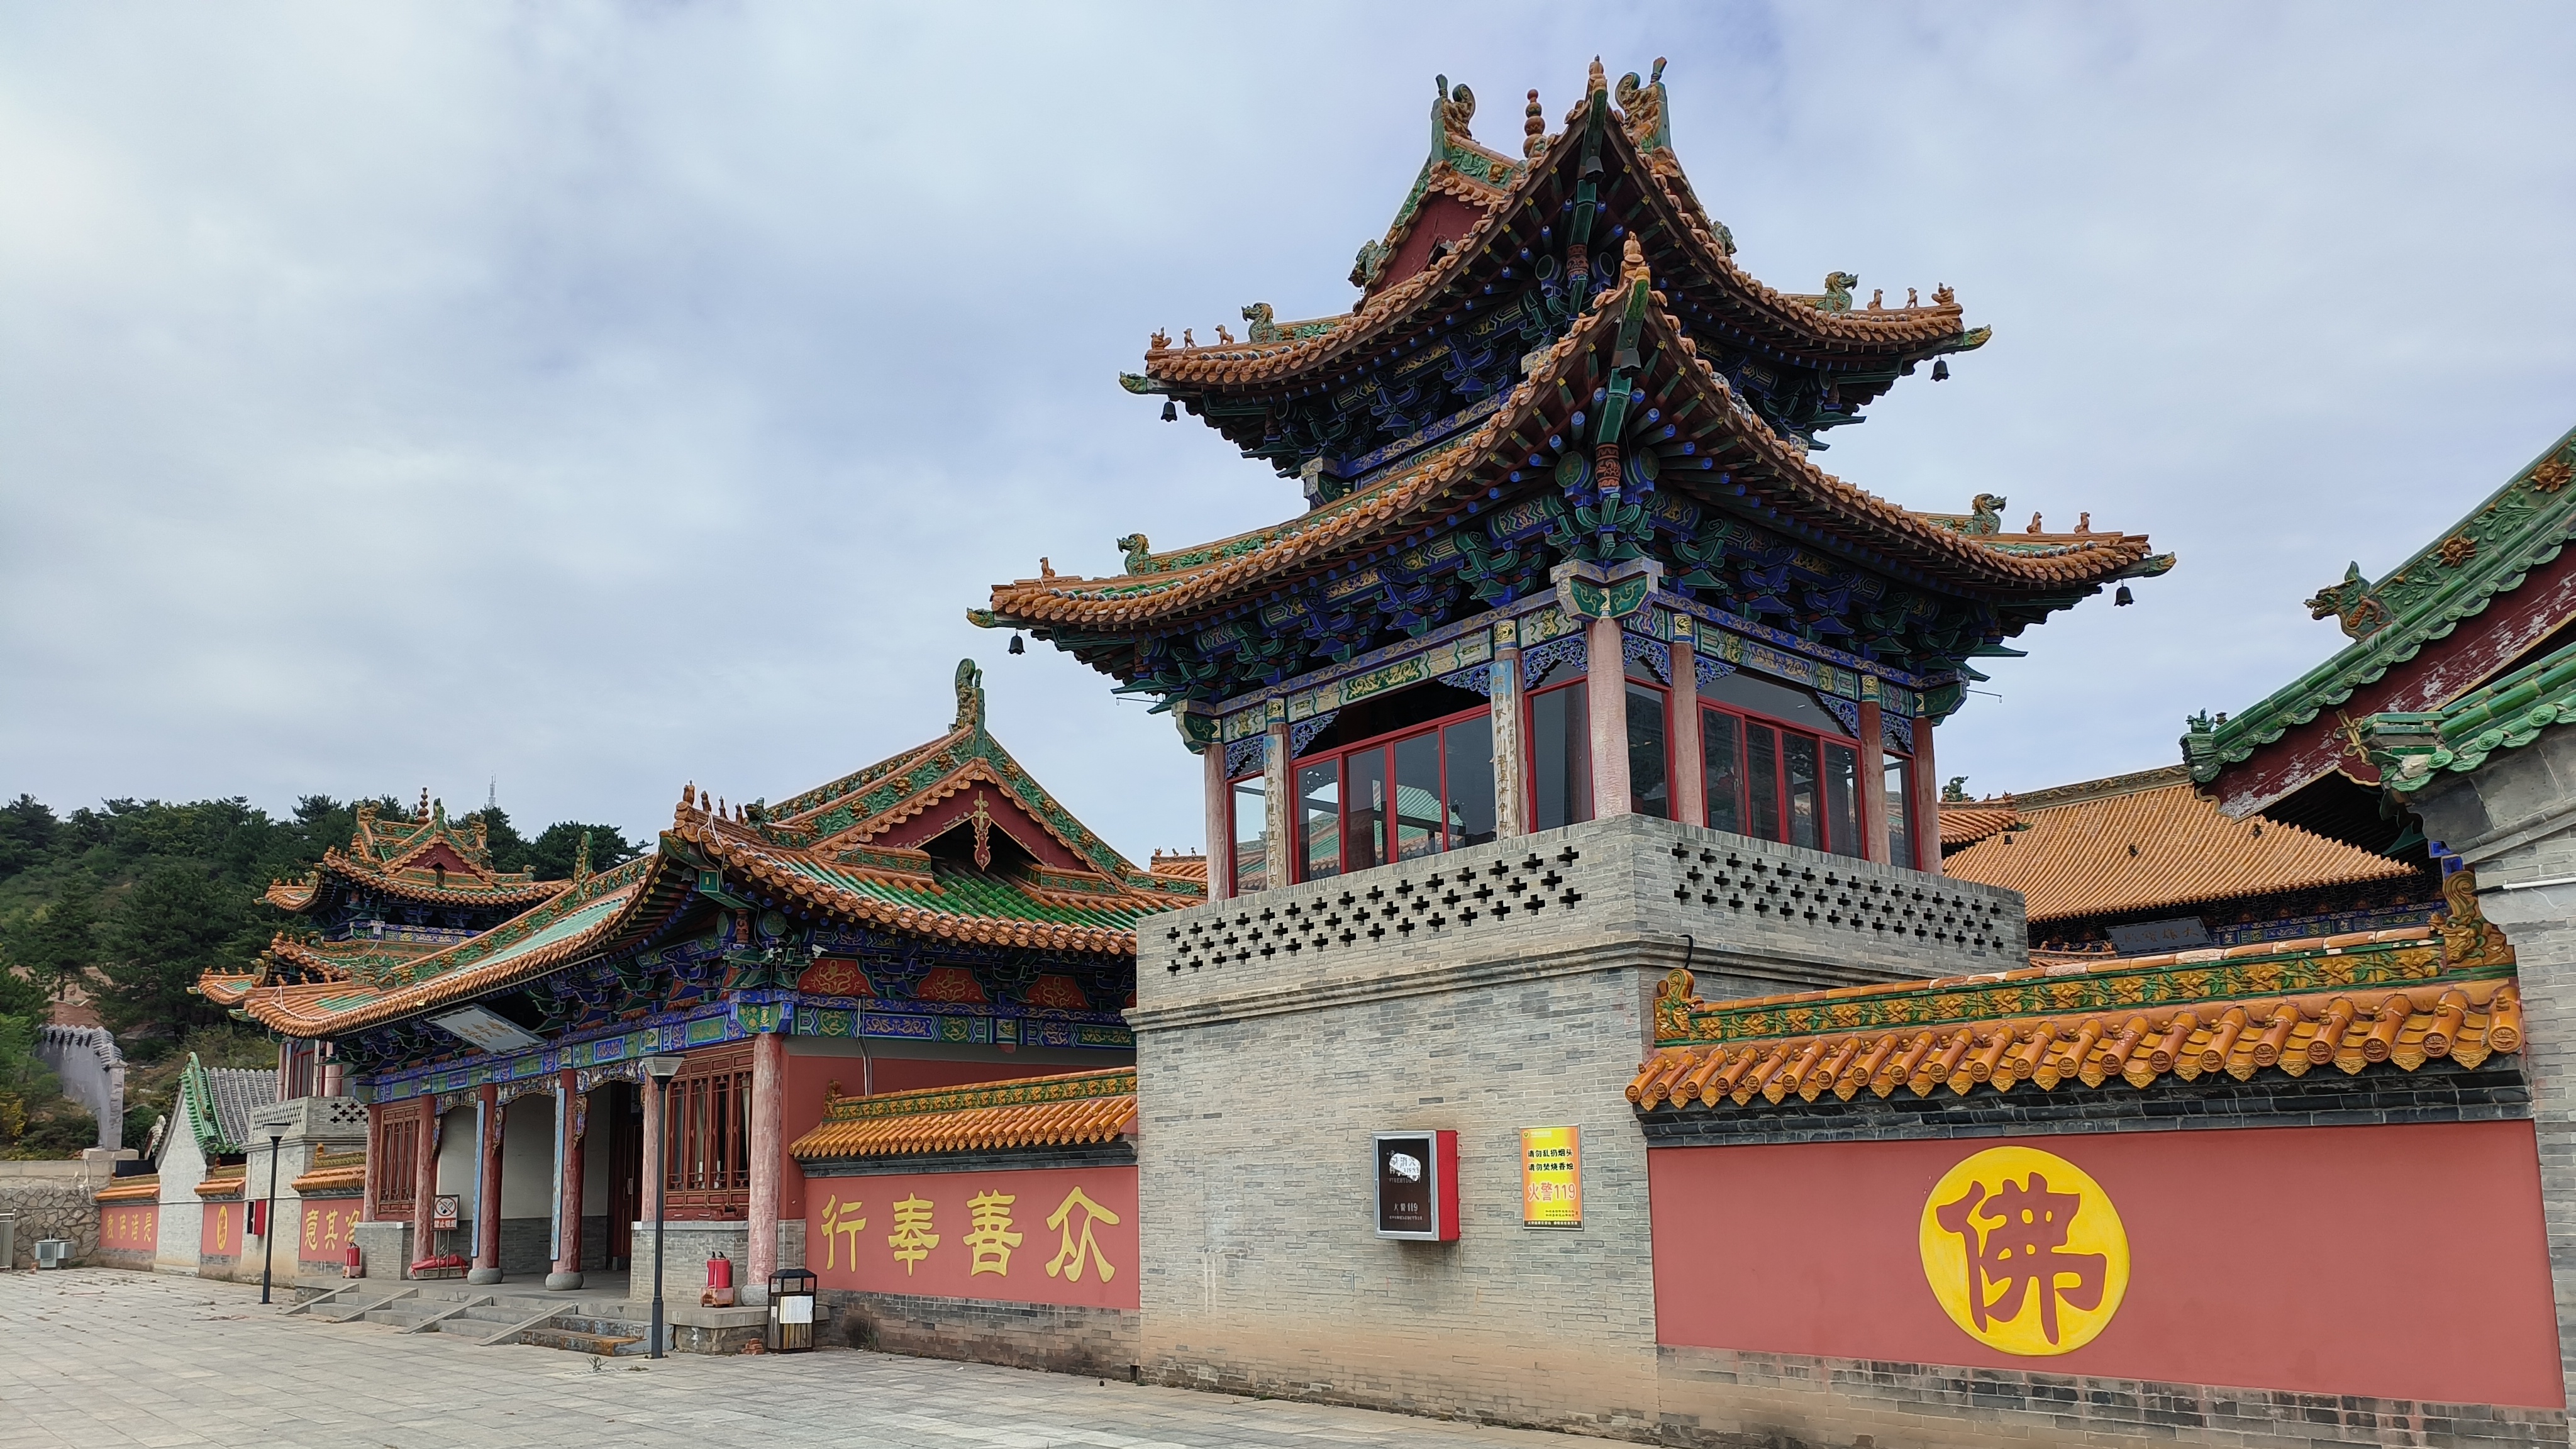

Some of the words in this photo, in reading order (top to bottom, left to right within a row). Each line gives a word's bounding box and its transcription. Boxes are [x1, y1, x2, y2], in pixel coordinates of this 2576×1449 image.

[1528, 1149, 1573, 1158] 请勿乱扔烟头
[1528, 1162, 1574, 1171] 请勿焚烧香烛
[1528, 1182, 1577, 1201] 火警119
[1936, 1171, 2107, 1346] 佛
